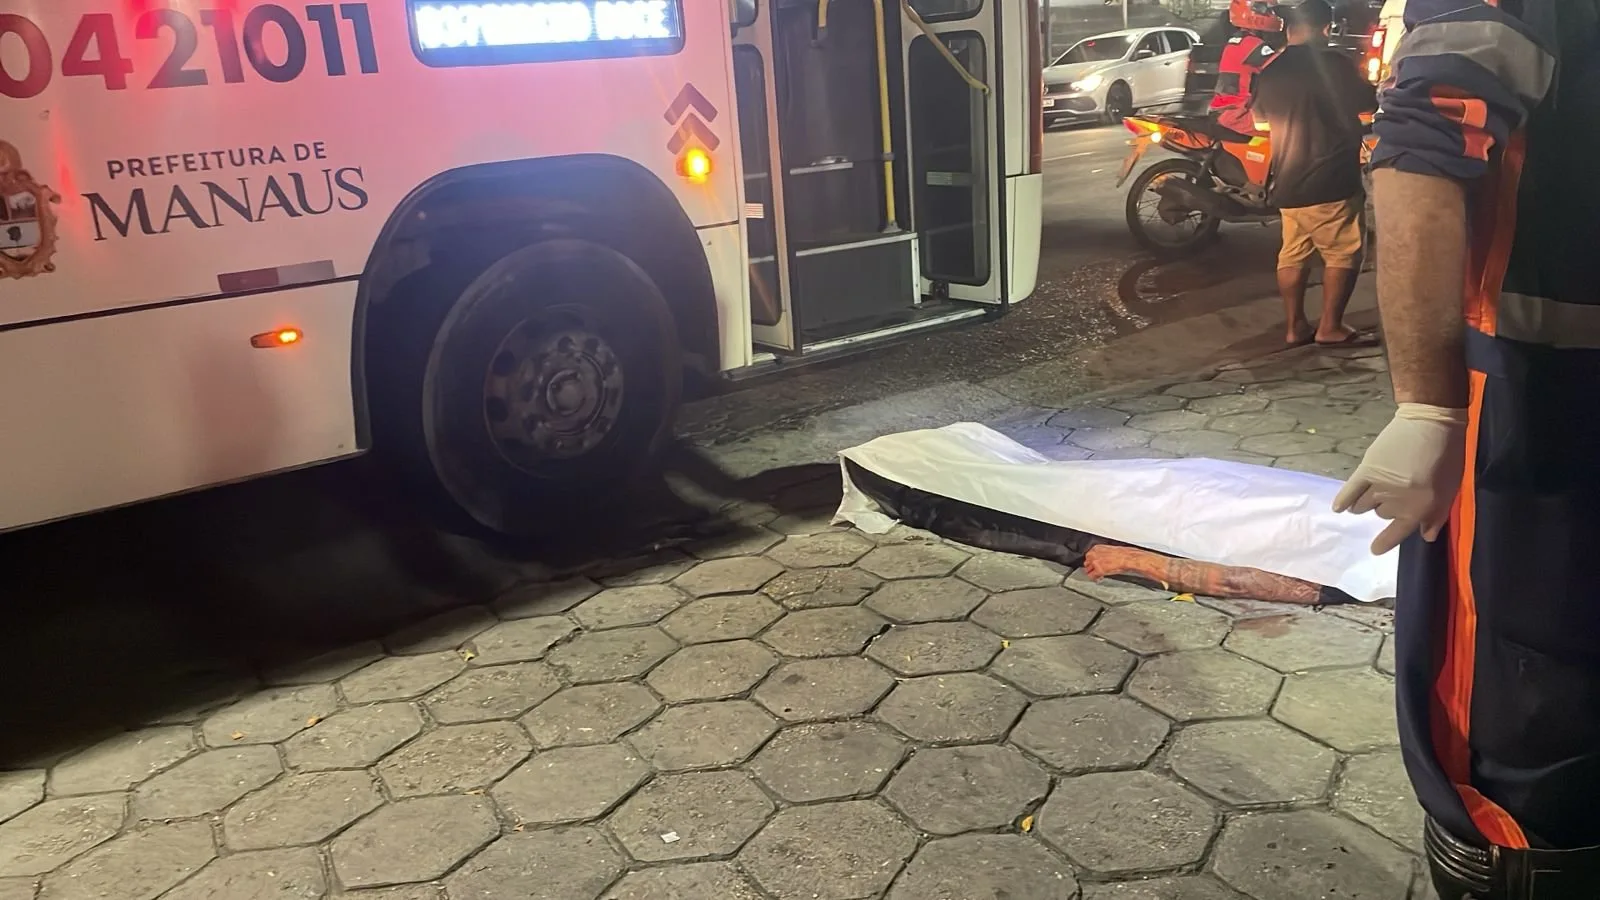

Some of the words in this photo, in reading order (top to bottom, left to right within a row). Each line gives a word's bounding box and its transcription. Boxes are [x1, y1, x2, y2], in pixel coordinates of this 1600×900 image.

[0, 3, 379, 99] 0421011
[107, 145, 287, 180] PREFEITURA
[294, 141, 327, 162] DE
[81, 167, 369, 242] MANAUS
